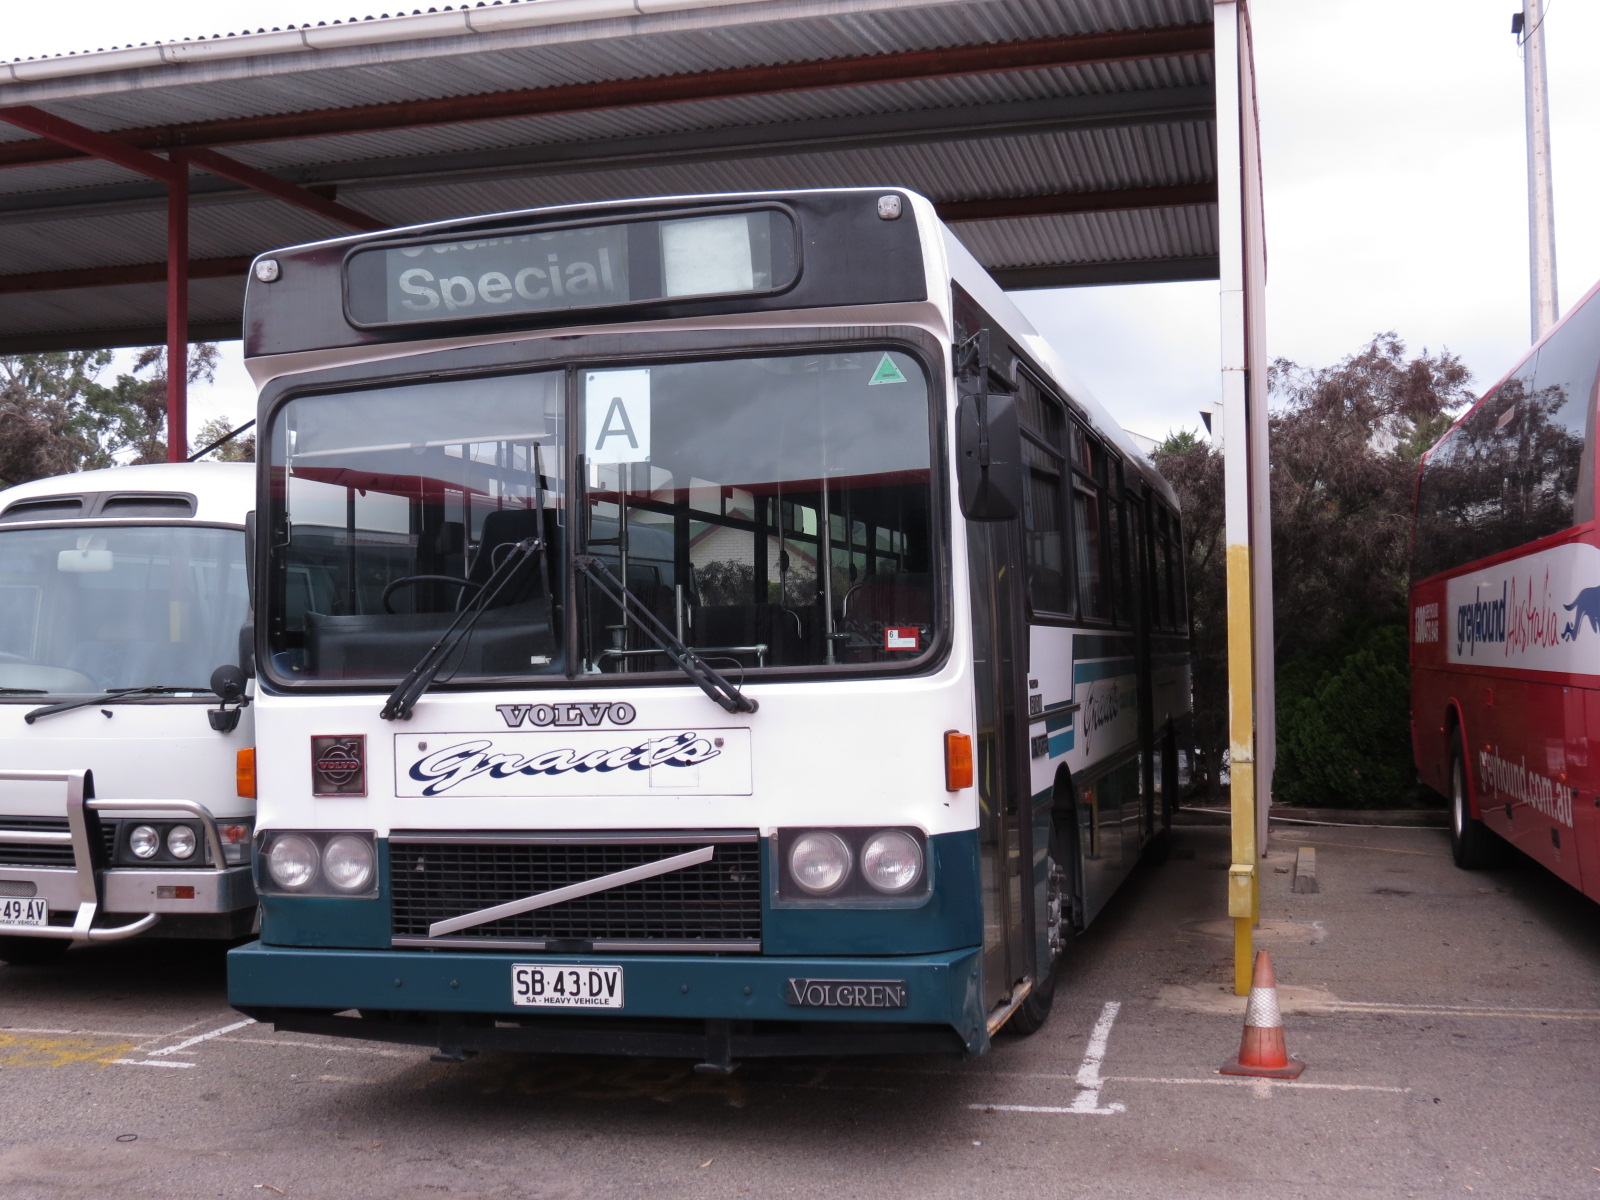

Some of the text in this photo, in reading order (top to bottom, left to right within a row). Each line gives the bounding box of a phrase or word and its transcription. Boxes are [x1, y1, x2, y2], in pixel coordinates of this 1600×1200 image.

[399, 246, 616, 312] Special
[594, 397, 639, 451] A
[1457, 563, 1560, 658] greyhound Australia
[889, 630, 894, 638] 6
[496, 702, 636, 727] VOLVO
[319, 761, 358, 769] VOLVO
[1479, 745, 1573, 829] greyhound.com.au
[788, 978, 902, 1007] VOLGREN
